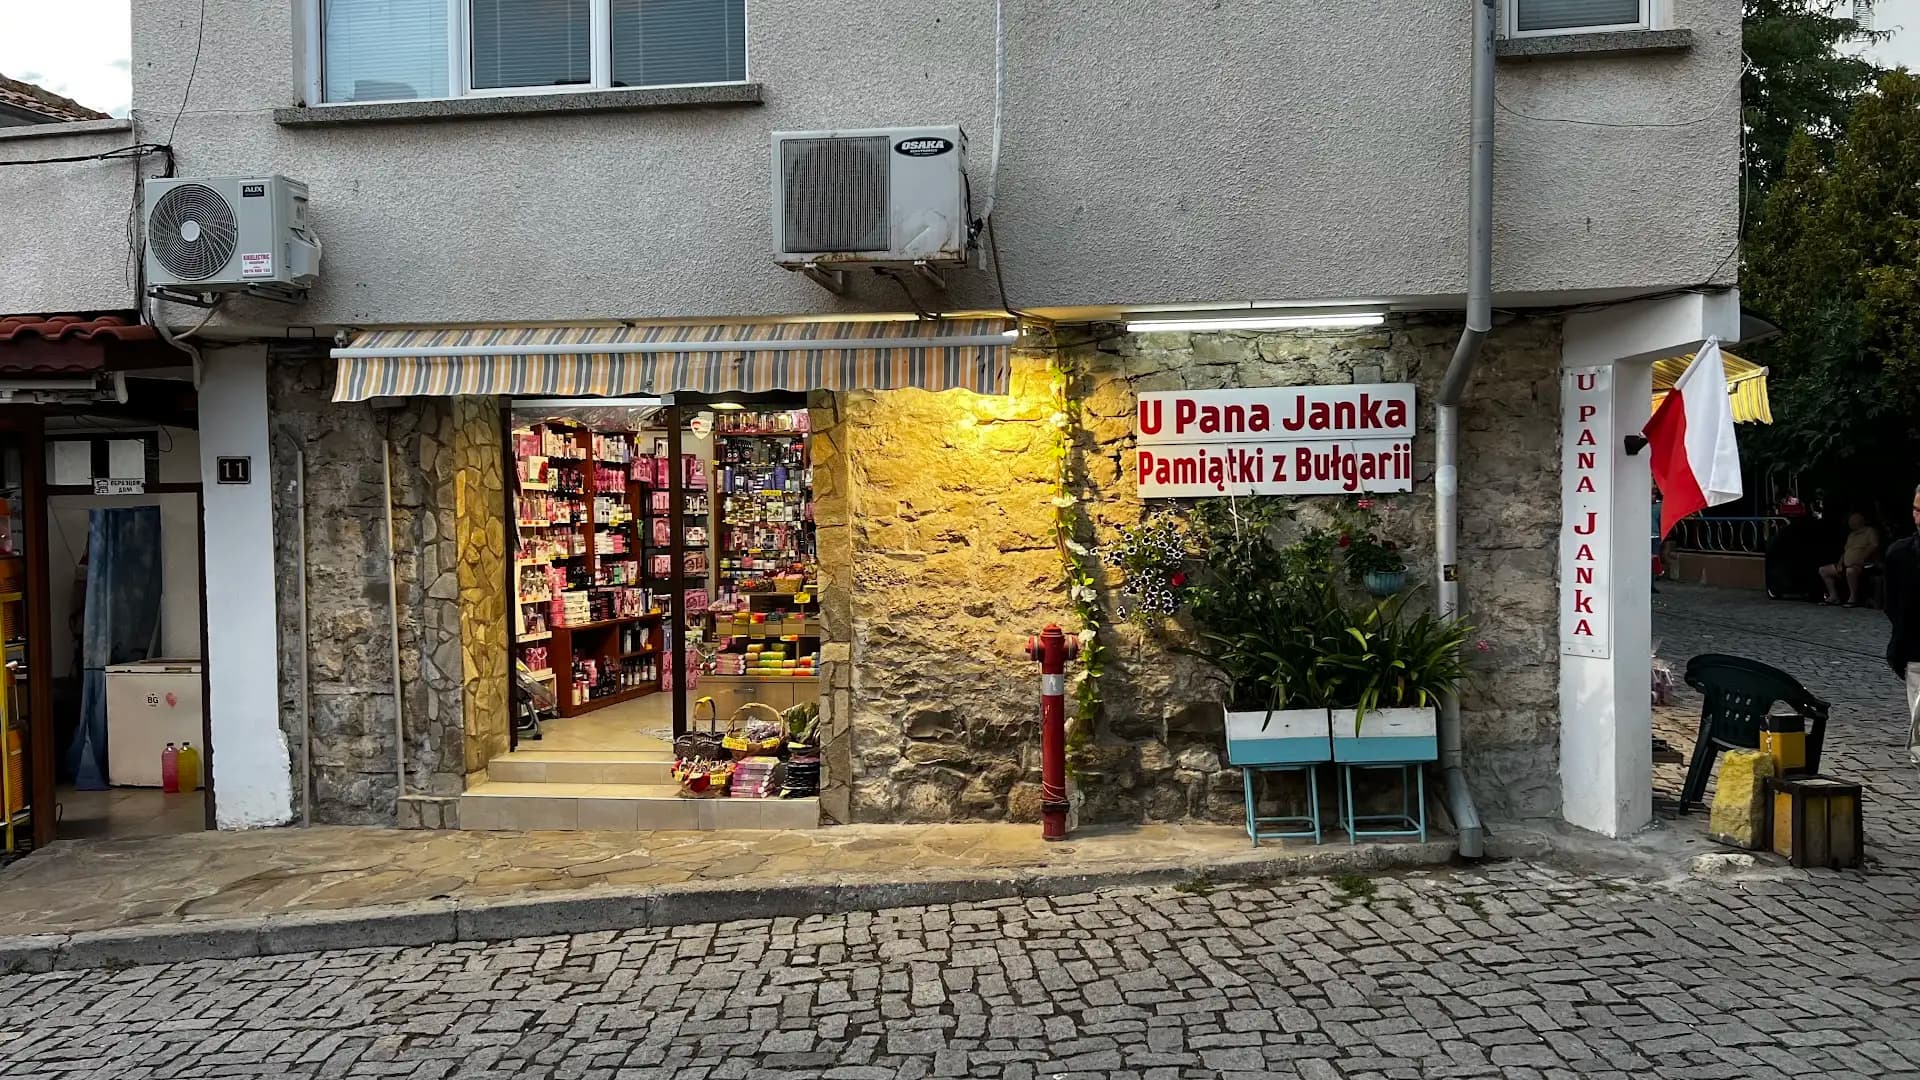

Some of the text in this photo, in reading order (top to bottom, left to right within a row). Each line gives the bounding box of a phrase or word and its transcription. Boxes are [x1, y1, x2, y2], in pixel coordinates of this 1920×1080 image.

[901, 140, 944, 150] OSAKA
[1576, 373, 1597, 391] U
[1139, 393, 1408, 436] U Pana Janka
[1575, 405, 1597, 493] PANA
[223, 461, 245, 479] 11
[1138, 443, 1411, 492] Pamiątki z Bułgarii
